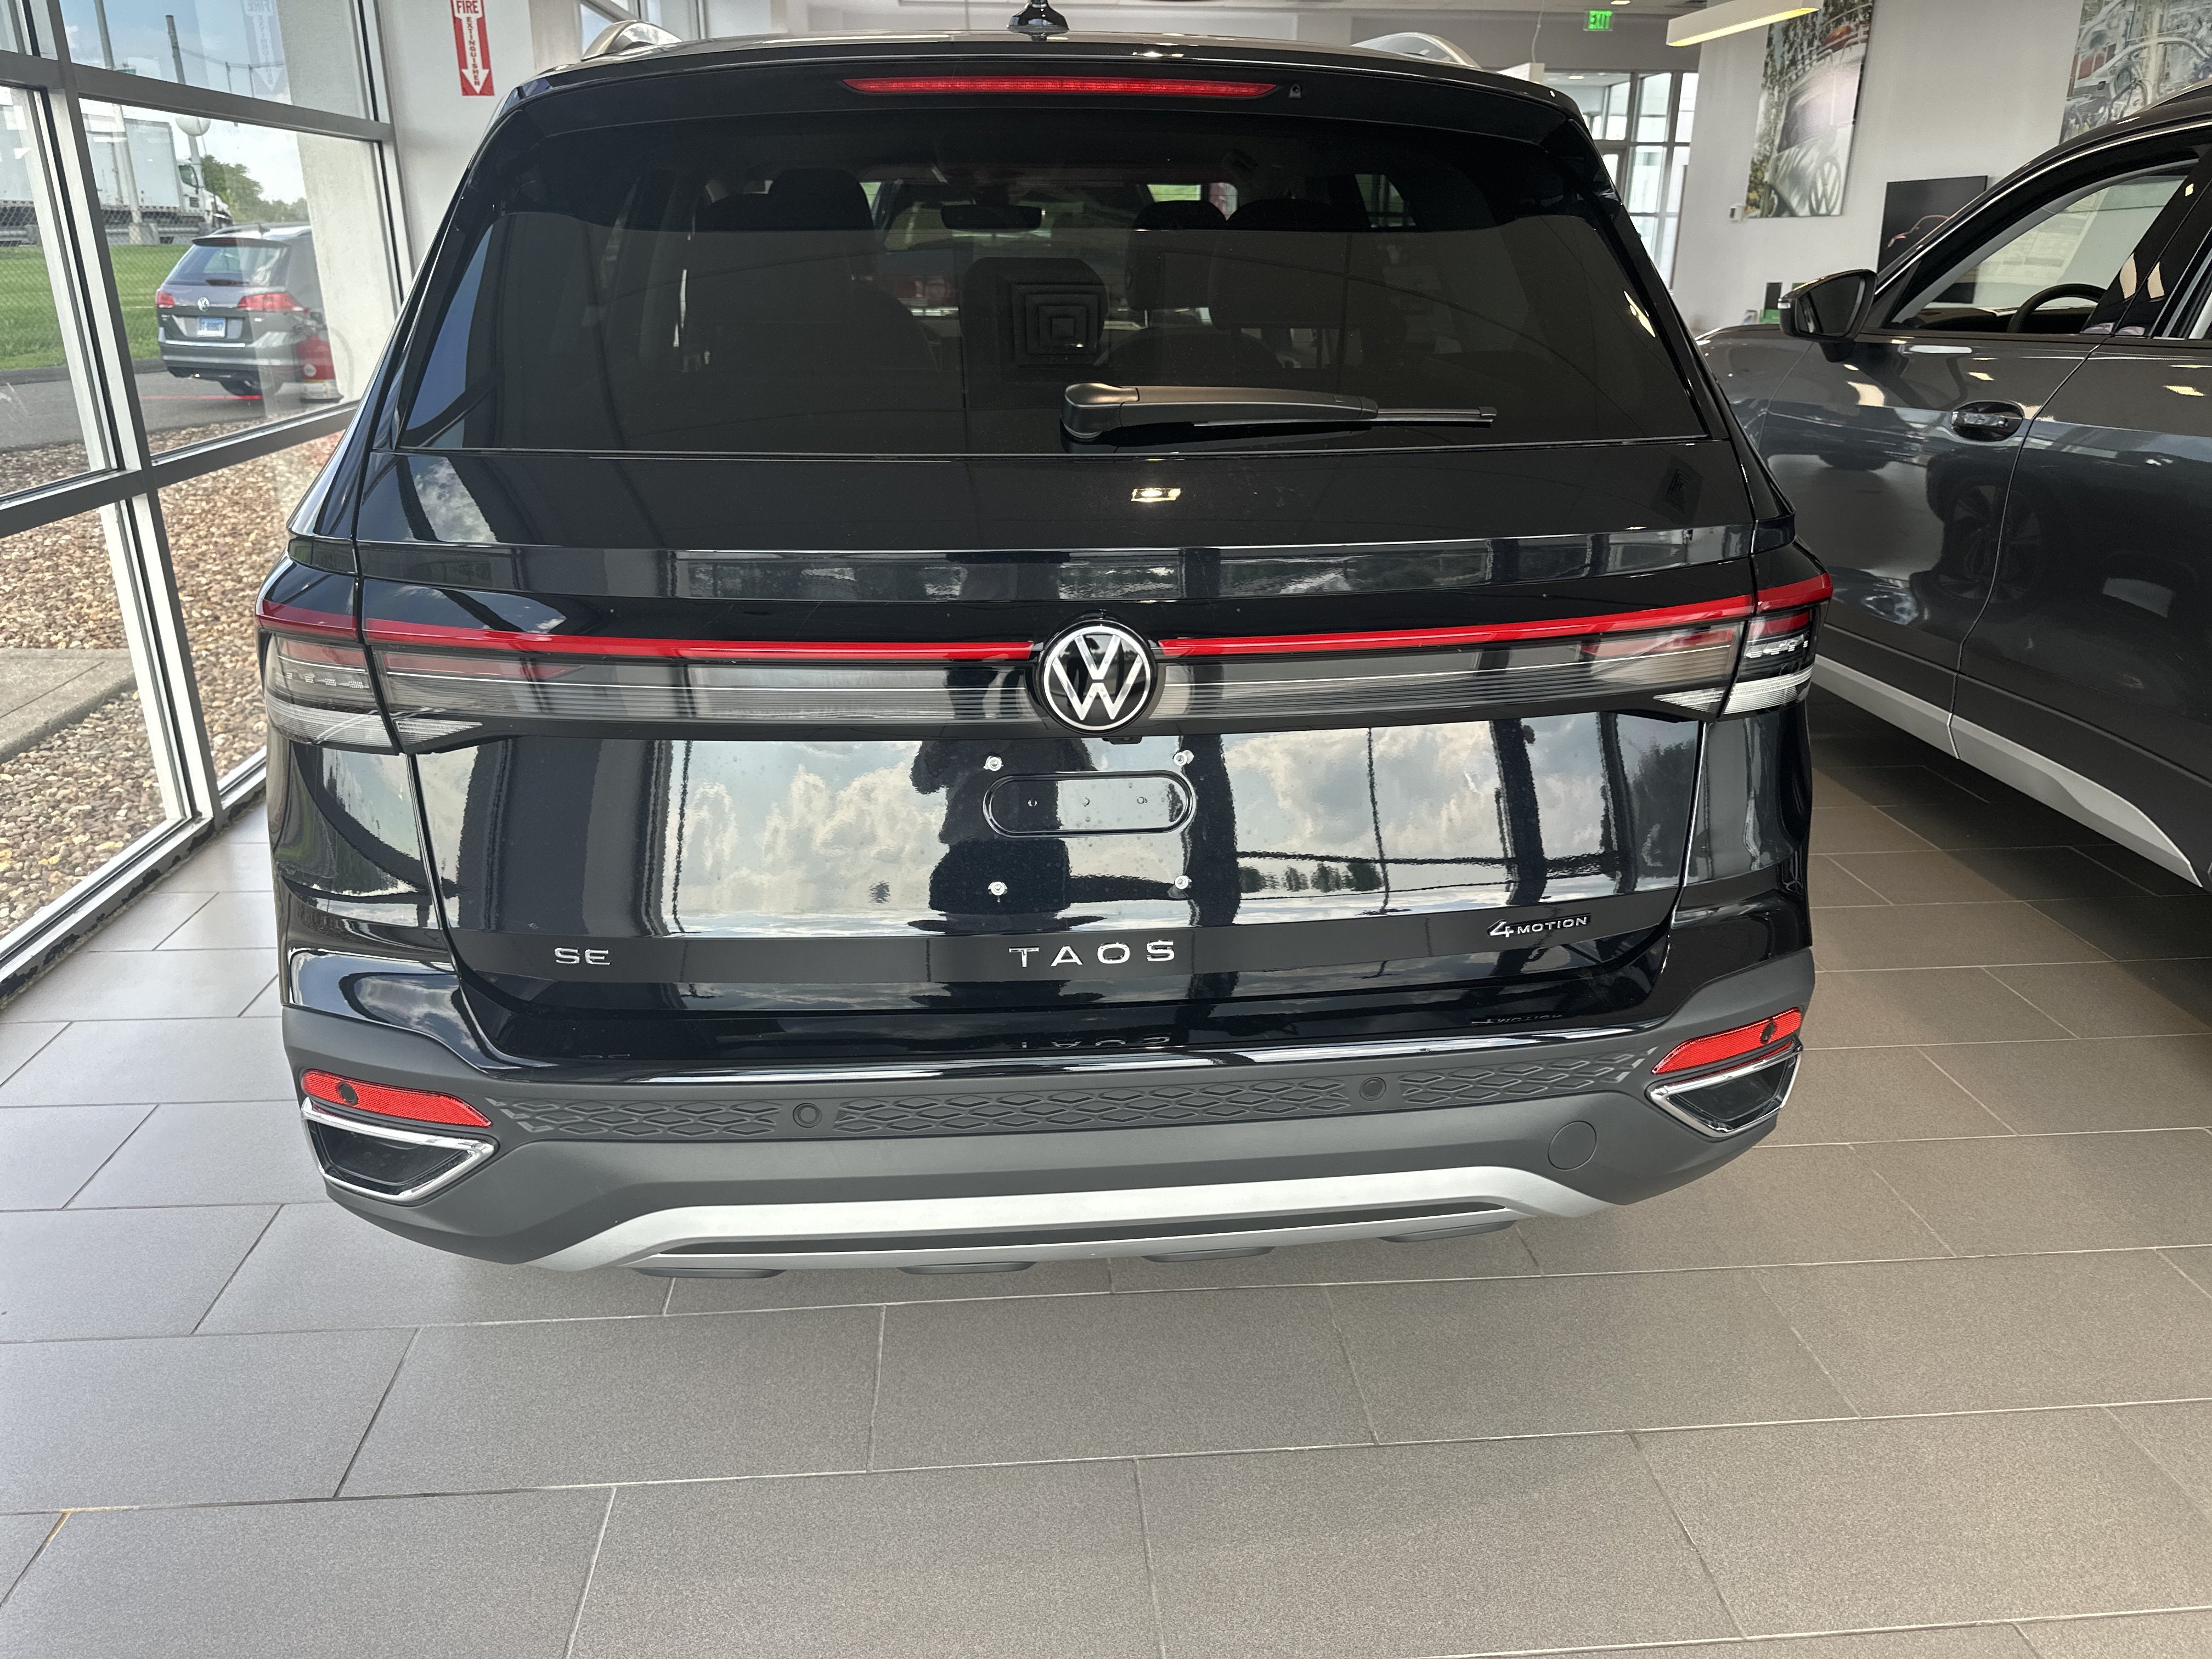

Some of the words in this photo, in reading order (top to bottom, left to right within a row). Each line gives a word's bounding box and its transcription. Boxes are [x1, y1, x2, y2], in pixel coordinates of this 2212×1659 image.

[456, 1, 479, 14] FIRE
[1588, 10, 1612, 29] EXIT
[466, 16, 480, 86] EXTINGUISHER
[1050, 633, 1145, 722] VW
[1488, 917, 1588, 938] 4MOTION
[555, 947, 611, 965] SE
[1008, 939, 1175, 968] TAOS
